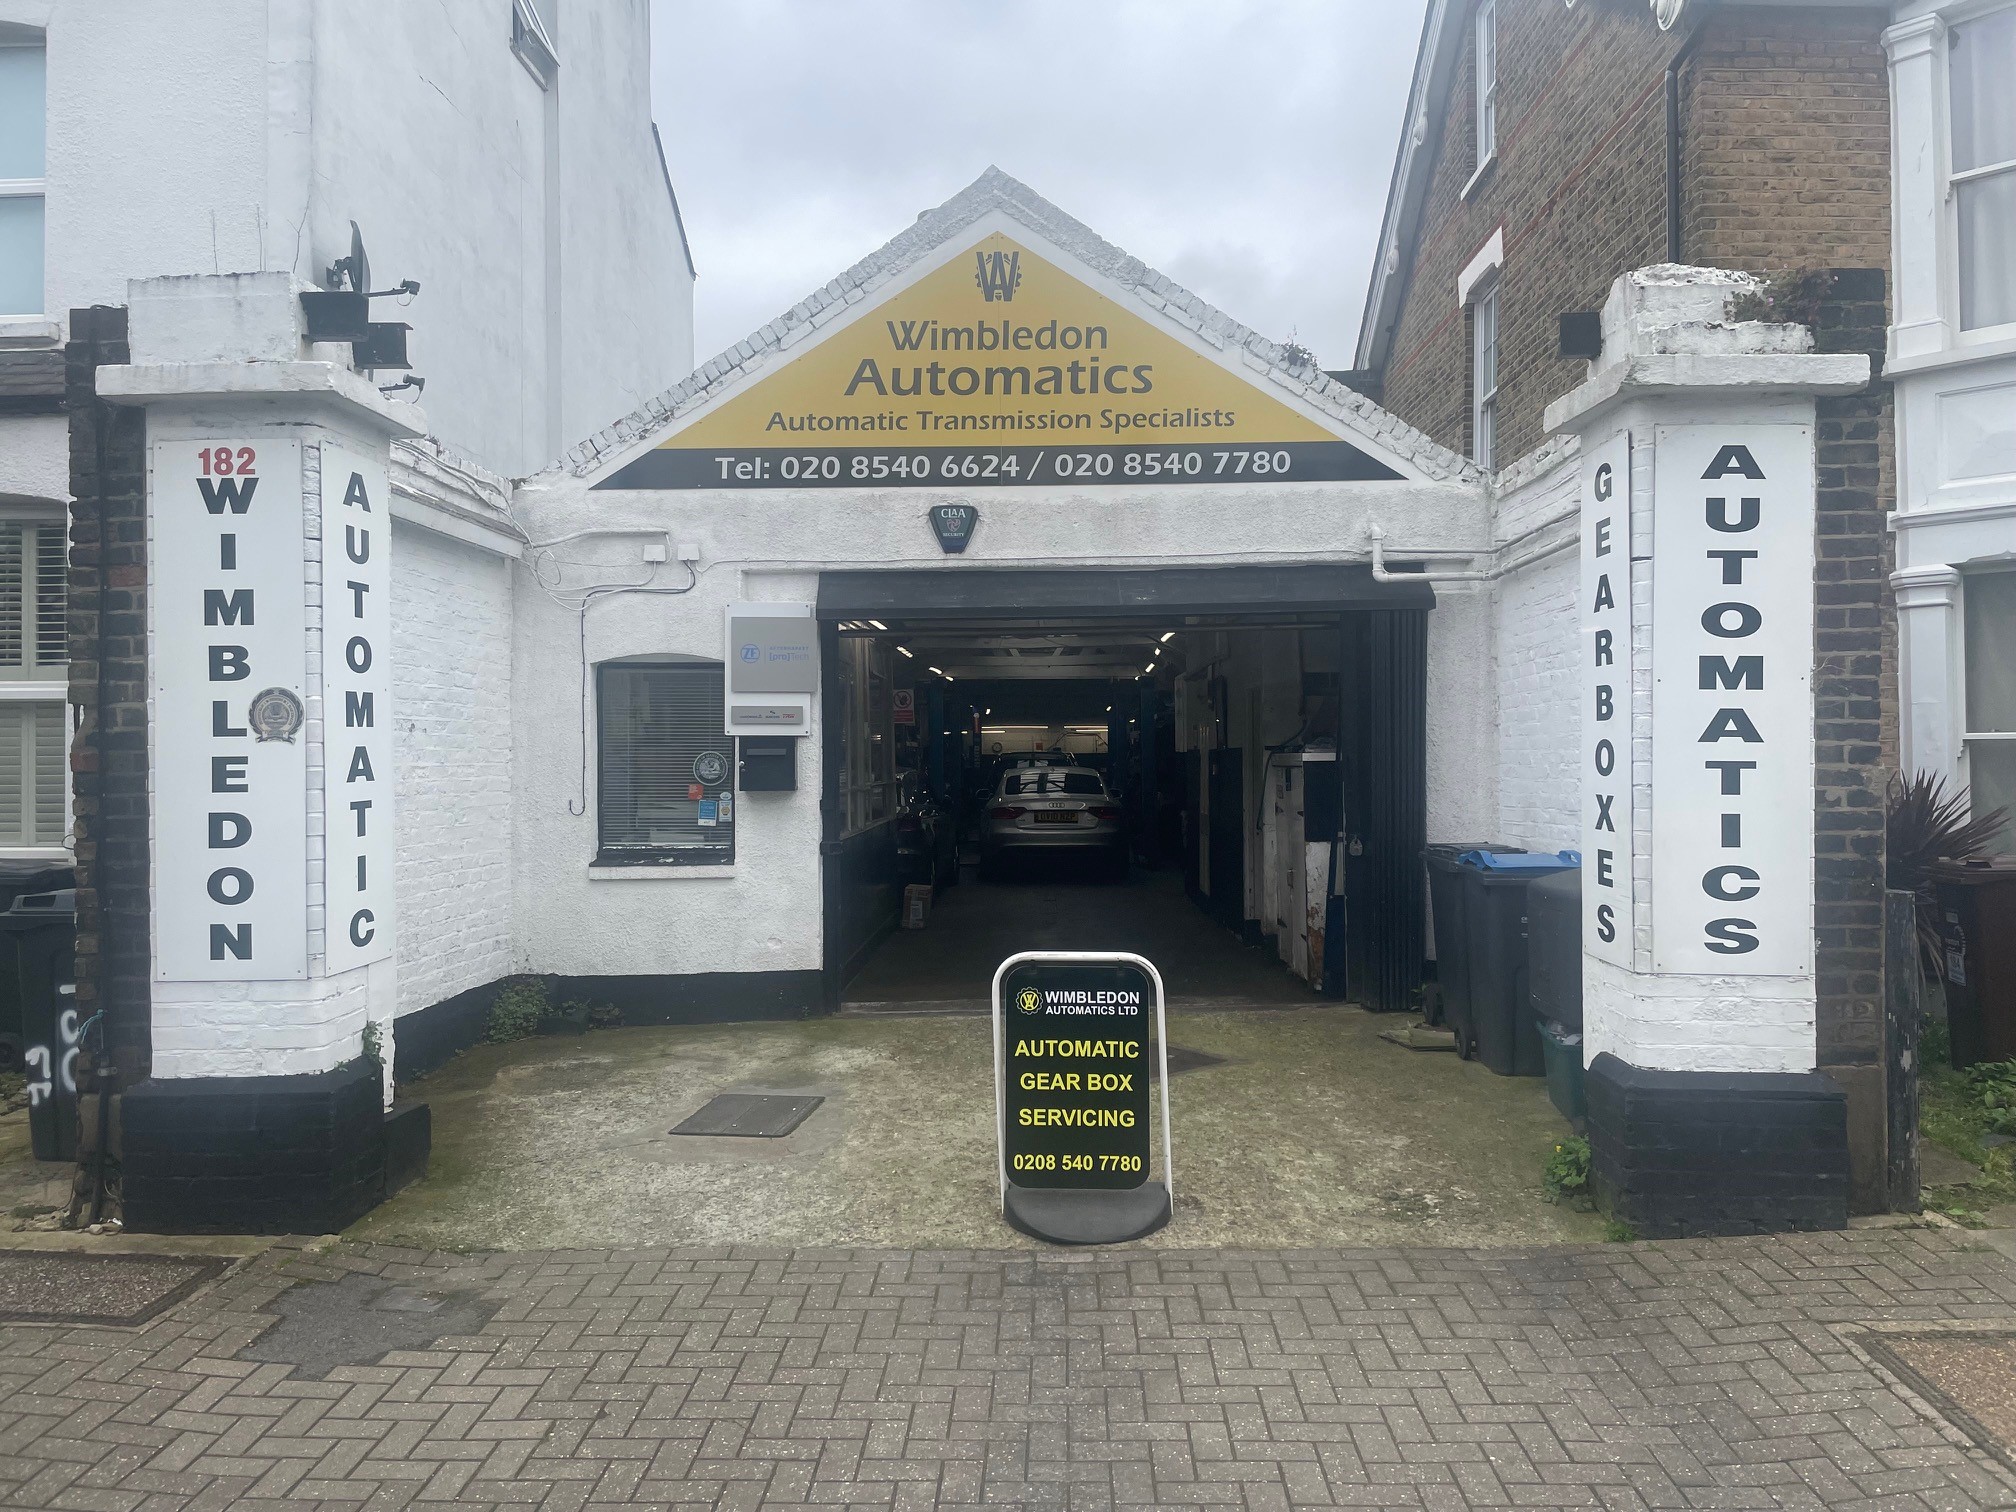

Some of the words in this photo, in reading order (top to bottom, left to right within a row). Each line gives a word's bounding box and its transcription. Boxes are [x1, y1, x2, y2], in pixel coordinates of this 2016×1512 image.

[887, 320, 1108, 353] Wimbledon
[844, 356, 1153, 397] Automatics
[766, 410, 908, 432] Automatic
[917, 409, 1091, 431] Transmission
[1100, 408, 1235, 436] Specialists
[198, 447, 257, 475] 182
[715, 457, 770, 480] Tel:
[780, 456, 841, 479] 020
[851, 455, 930, 479] 8540
[941, 454, 1020, 478] 6624
[1026, 451, 1045, 481] /
[1055, 453, 1114, 477] 020
[1124, 452, 1203, 476] 8540
[1212, 450, 1291, 474] 7780
[940, 508, 966, 519] CLAA
[342, 471, 376, 948] AUTOMATIC
[1593, 462, 1616, 944] GEARBOXES
[1697, 444, 1767, 955] AUTOMATICS
[196, 476, 260, 961] WIMBLEDON
[1044, 990, 1140, 1004] WIMBLEDON
[1045, 1005, 1116, 1016] AUTOMATICS
[1118, 1005, 1139, 1016] LTD
[1014, 1039, 1139, 1059] AUTOMATIC
[1020, 1072, 1081, 1091] GEAR
[1087, 1073, 1134, 1092] BOX
[1018, 1108, 1135, 1128] SERVICING
[1013, 1154, 1056, 1171] 0208
[1061, 1154, 1094, 1171] 540
[1099, 1155, 1142, 1172] 7780
